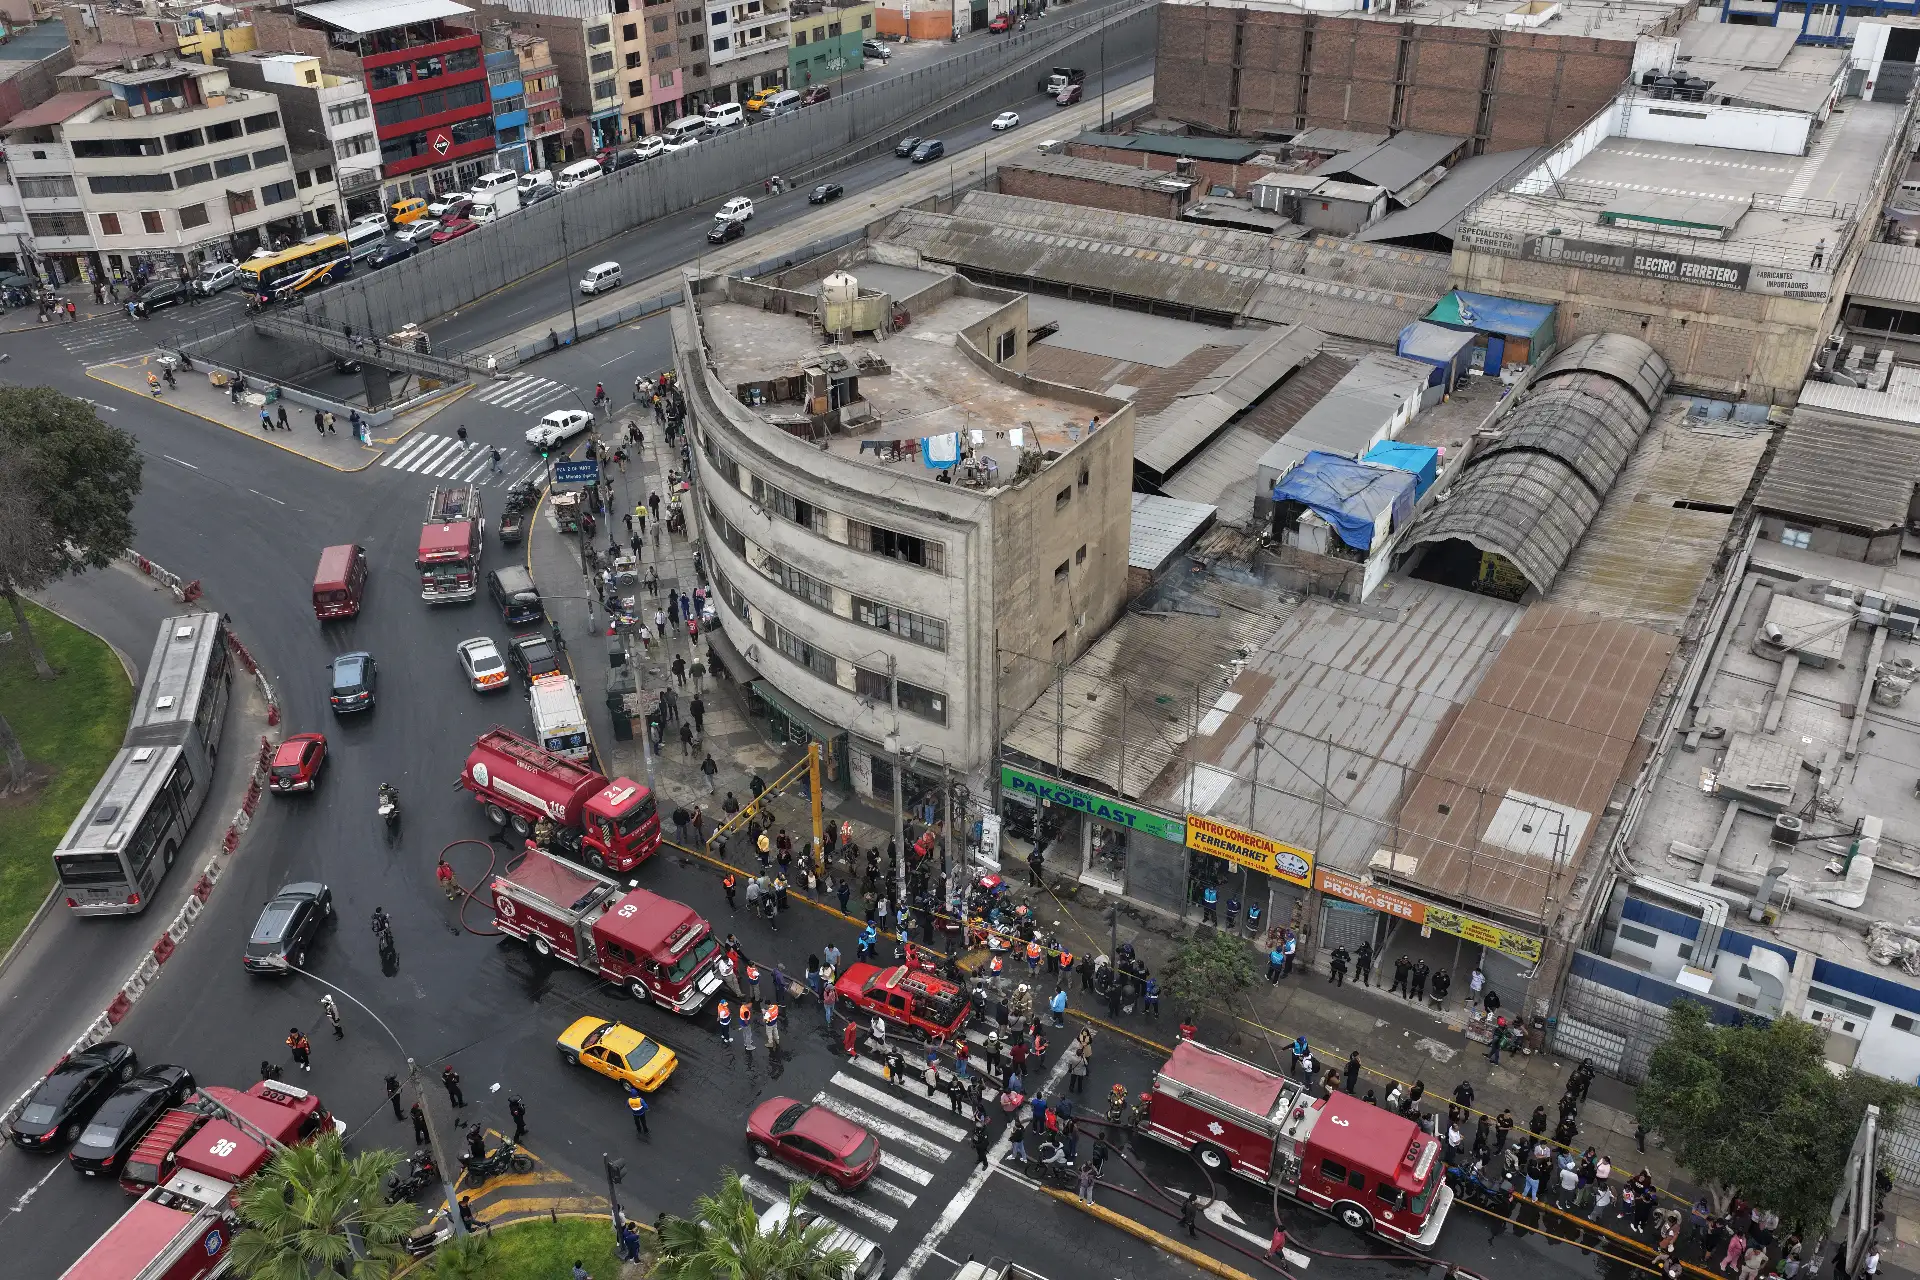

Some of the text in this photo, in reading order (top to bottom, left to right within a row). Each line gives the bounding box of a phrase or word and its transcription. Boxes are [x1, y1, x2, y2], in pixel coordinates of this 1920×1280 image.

[1458, 227, 1513, 241] ESPECIALISTAS
[1633, 255, 1738, 282] ELECTRO FERRETERO
[1757, 271, 1793, 280] FABRICANTES
[1766, 280, 1808, 290] IMPORTADORES
[1783, 289, 1827, 299] DISTRIBUIDORES
[603, 786, 623, 800] 21
[549, 800, 566, 816] 116
[1012, 776, 1137, 828] PAKOPLAST
[1188, 816, 1276, 854] CENTRO COMERCIAL
[1194, 831, 1268, 862] FERREMARKET
[1331, 1115, 1349, 1127] 3
[209, 1138, 237, 1157] 36
[1324, 1185, 1332, 1195] 3
